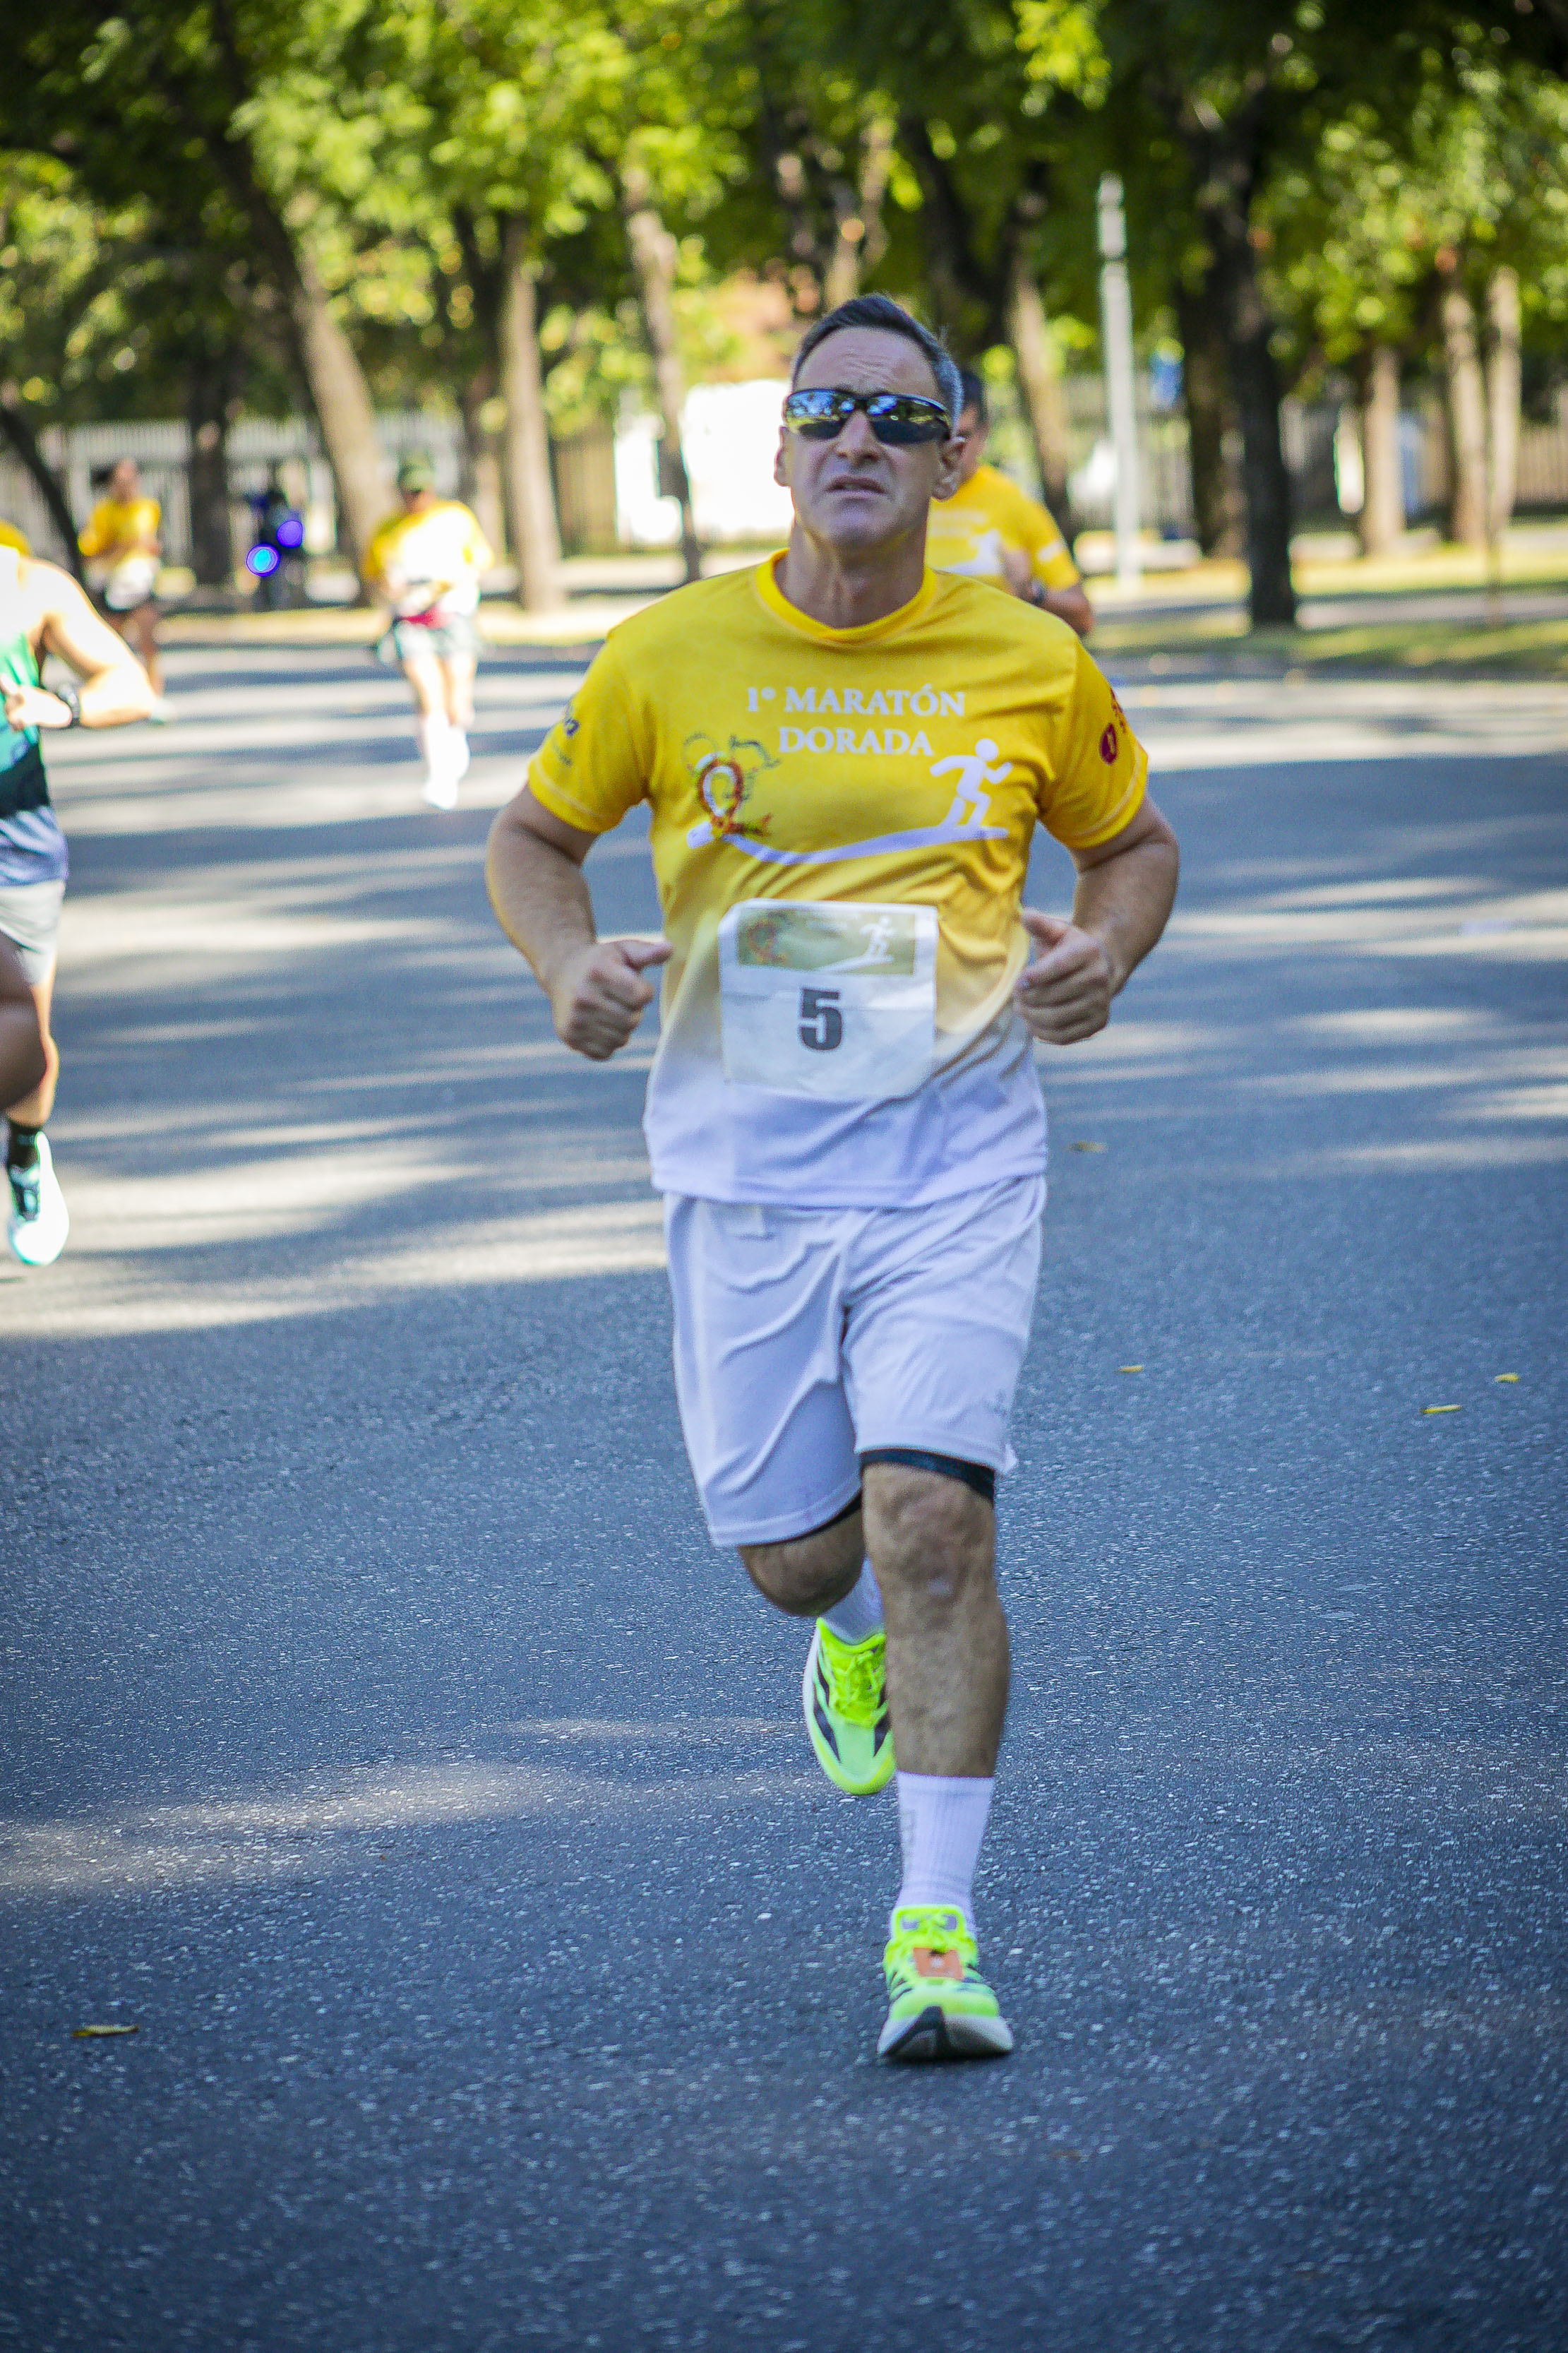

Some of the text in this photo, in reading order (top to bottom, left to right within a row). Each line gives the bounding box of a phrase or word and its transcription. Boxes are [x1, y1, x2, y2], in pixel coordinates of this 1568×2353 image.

[785, 684, 965, 716] MARATÓN
[779, 727, 933, 756] DORADA
[799, 987, 843, 1051] 5
